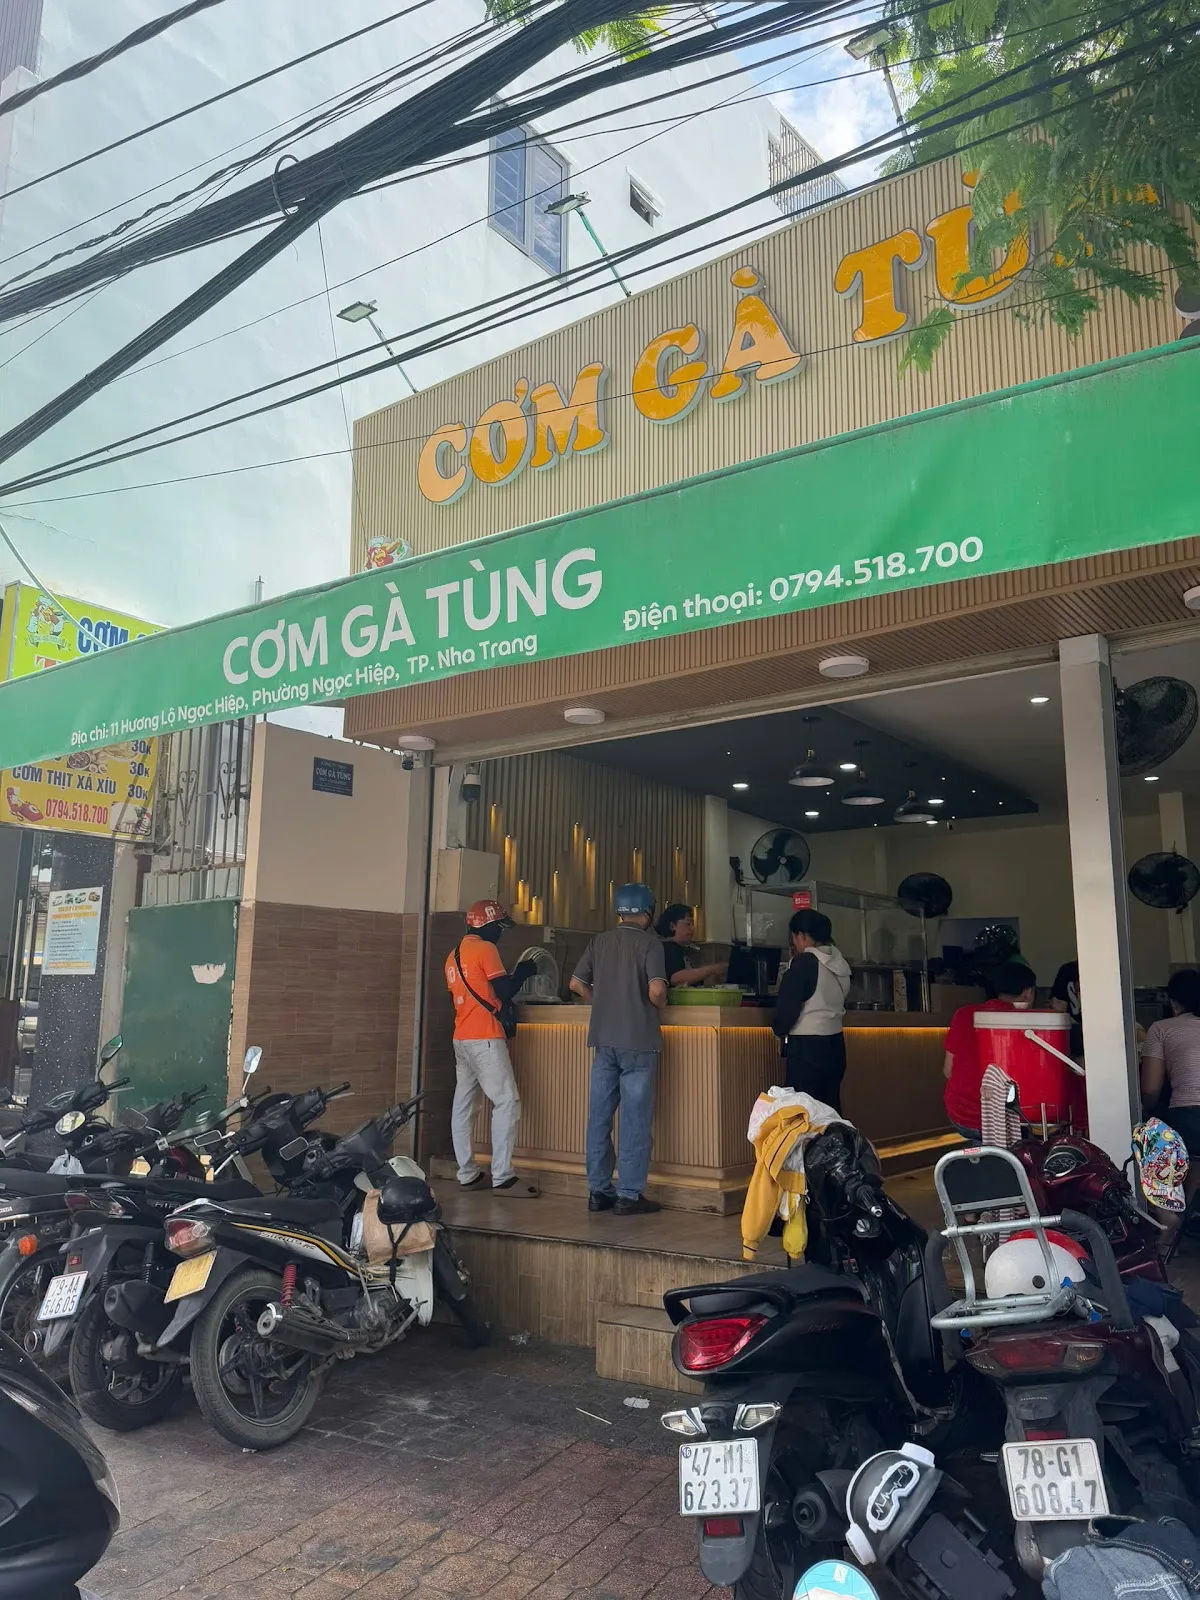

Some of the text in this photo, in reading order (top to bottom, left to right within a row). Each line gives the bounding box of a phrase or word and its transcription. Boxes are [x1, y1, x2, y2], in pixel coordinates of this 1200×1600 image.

[417, 360, 611, 505] CƠM
[222, 547, 603, 685] CƠM GÀ TÙNG
[622, 536, 985, 631] Điện thoại: 0794.518.700
[71, 731, 88, 748] Địa
[110, 722, 119, 738] 11
[121, 714, 160, 735] Hương
[161, 707, 176, 727] Lộ
[177, 703, 213, 724] Ngọc
[215, 693, 249, 715] Hiệp,
[252, 682, 310, 707] Phường
[312, 673, 354, 697] Ngọc
[355, 662, 400, 686] Hiệp,
[407, 653, 435, 675] TP.
[437, 647, 476, 669] Nha
[479, 634, 538, 660] Trang
[45, 798, 108, 825] 0794.518.700
[47, 769, 74, 790] THỊT
[96, 778, 117, 795] XÍU
[684, 1476, 754, 1512] 623.37
[1017, 1445, 1083, 1480] 78-G1
